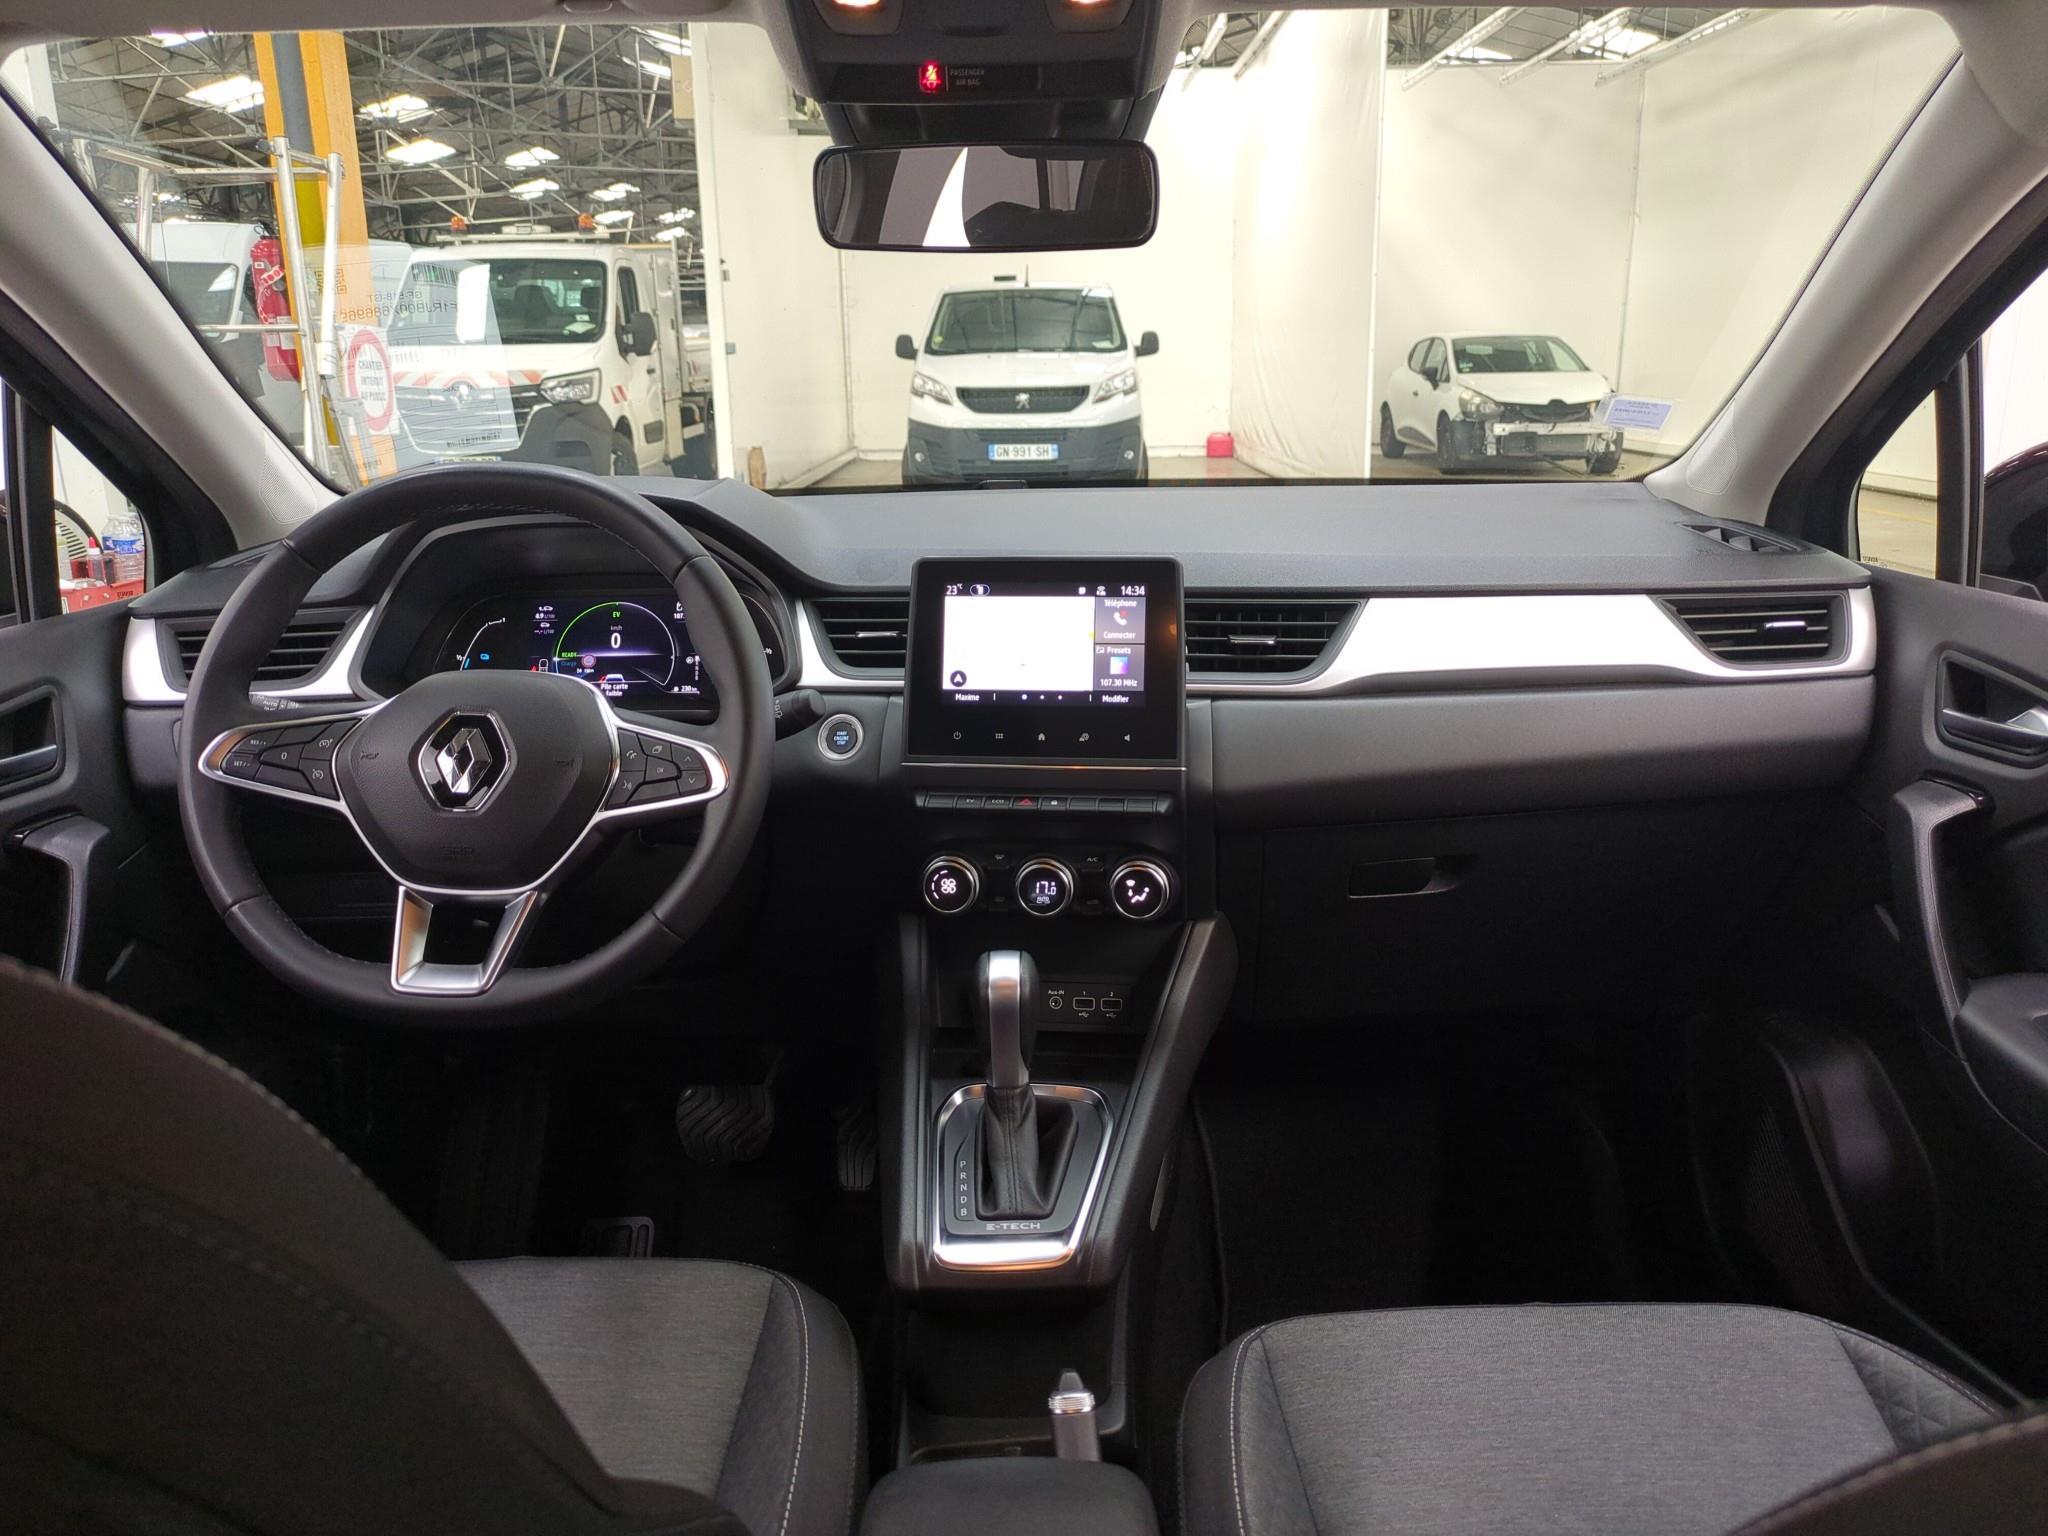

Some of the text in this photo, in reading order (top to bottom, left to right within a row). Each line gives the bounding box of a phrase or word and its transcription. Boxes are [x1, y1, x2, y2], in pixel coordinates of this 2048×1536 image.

[996, 446, 1050, 458] GN-991-SH
[1120, 585, 1146, 596] 14:34
[1104, 599, 1137, 608] Téléphone
[1103, 631, 1137, 639] Connecter
[610, 632, 621, 649] 0
[1107, 646, 1132, 655] Presets
[1100, 678, 1138, 687] 107.30 MHz
[605, 690, 624, 698] faible
[955, 692, 980, 701] Maxime
[1102, 694, 1130, 703] Modifier
[960, 1160, 966, 1169] P
[960, 1172, 967, 1180] R
[960, 1183, 968, 1192] N
[960, 1196, 968, 1204] D
[960, 1208, 968, 1216] B
[985, 1222, 1041, 1231] E-TECH
